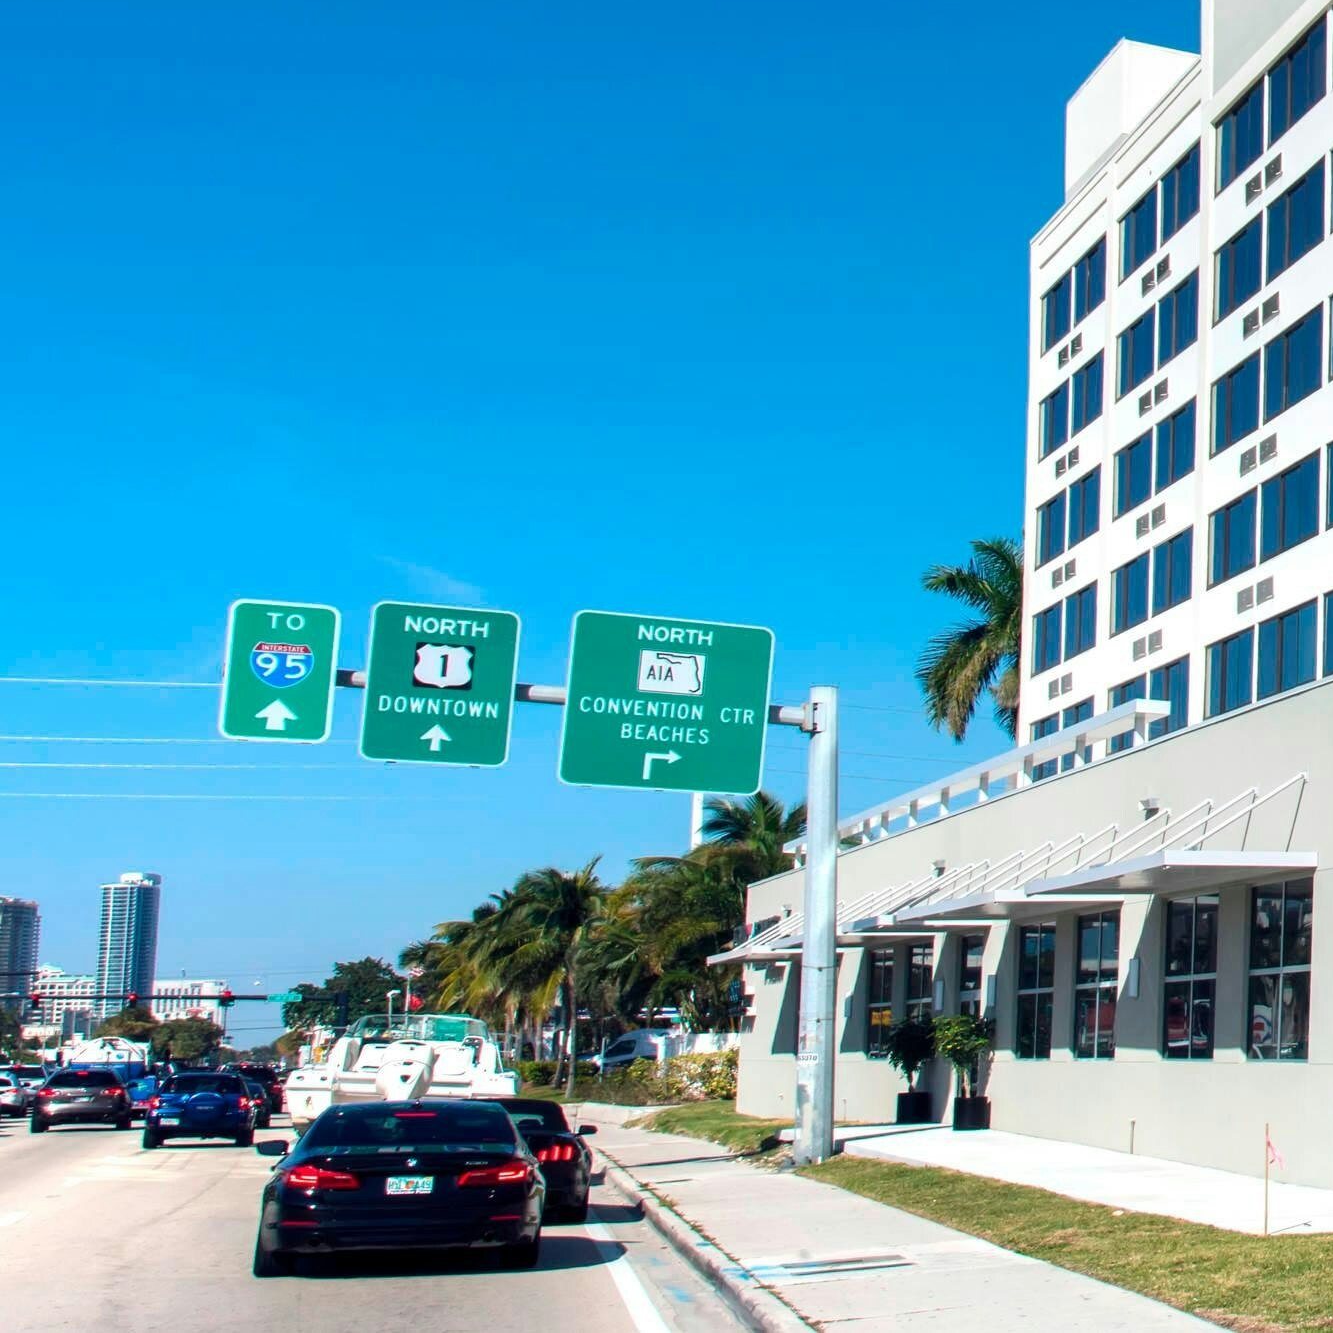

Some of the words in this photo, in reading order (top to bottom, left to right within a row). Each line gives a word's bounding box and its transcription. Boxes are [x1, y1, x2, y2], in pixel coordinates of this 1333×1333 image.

[266, 612, 306, 631] TO
[404, 615, 490, 638] NORTH
[638, 624, 714, 647] NORTH
[261, 644, 305, 653] INTERSTATE
[255, 653, 307, 679] 95
[440, 654, 449, 677] 1
[378, 694, 499, 718] DOWNTOWN
[579, 696, 704, 721] CONVENTION
[720, 707, 755, 725] CTR
[620, 723, 710, 745] BEACHES
